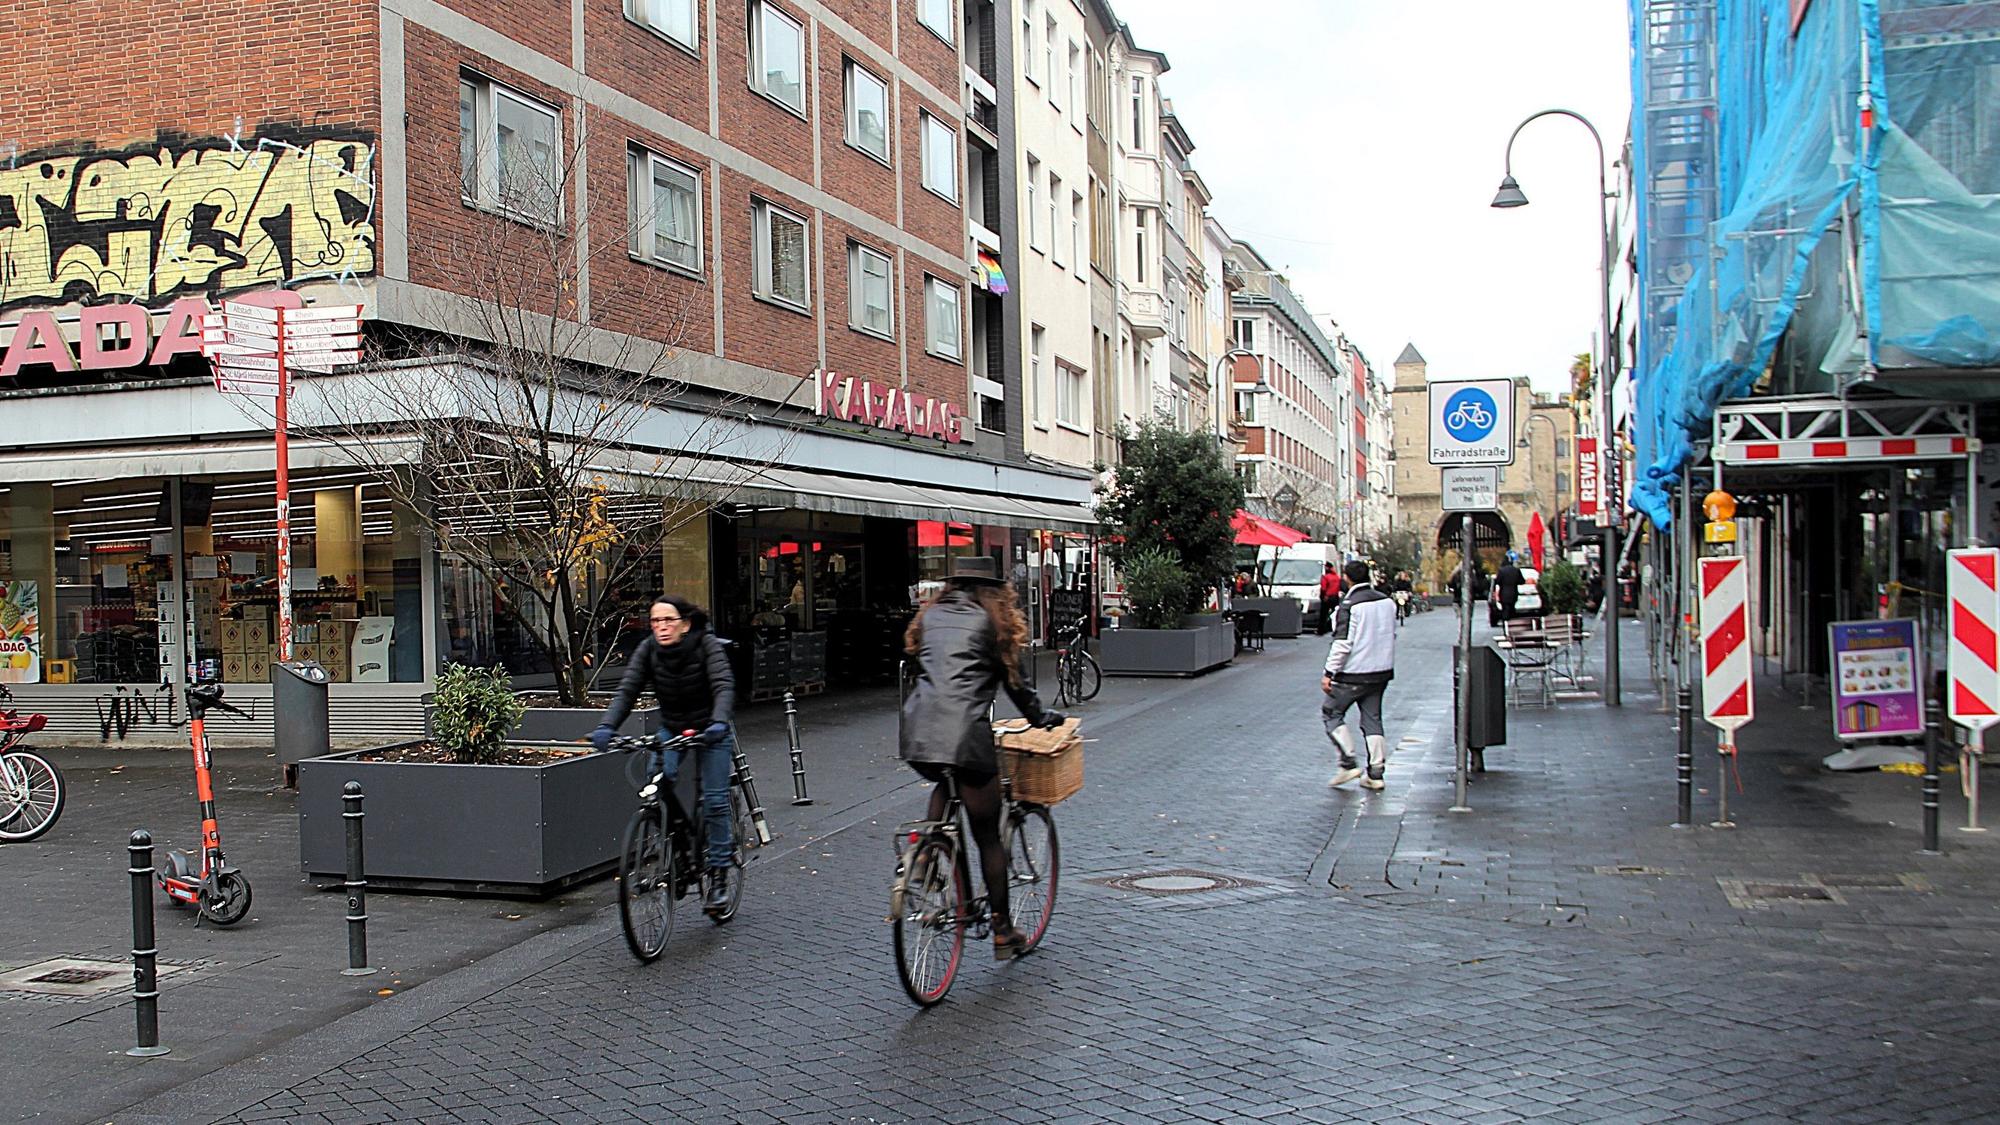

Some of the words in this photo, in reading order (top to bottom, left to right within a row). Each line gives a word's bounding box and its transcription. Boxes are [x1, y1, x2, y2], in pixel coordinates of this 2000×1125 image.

[233, 305, 252, 314] Altstadt
[234, 320, 249, 329] Polizei
[330, 323, 352, 331] Christi
[235, 335, 247, 343] Dom
[228, 356, 266, 366] Hauptbahnhof
[248, 372, 277, 381] Himmelfahrt
[815, 369, 961, 444] KARADAG
[1433, 446, 1506, 458] Fahrradstraße
[1580, 451, 1596, 502] REWE
